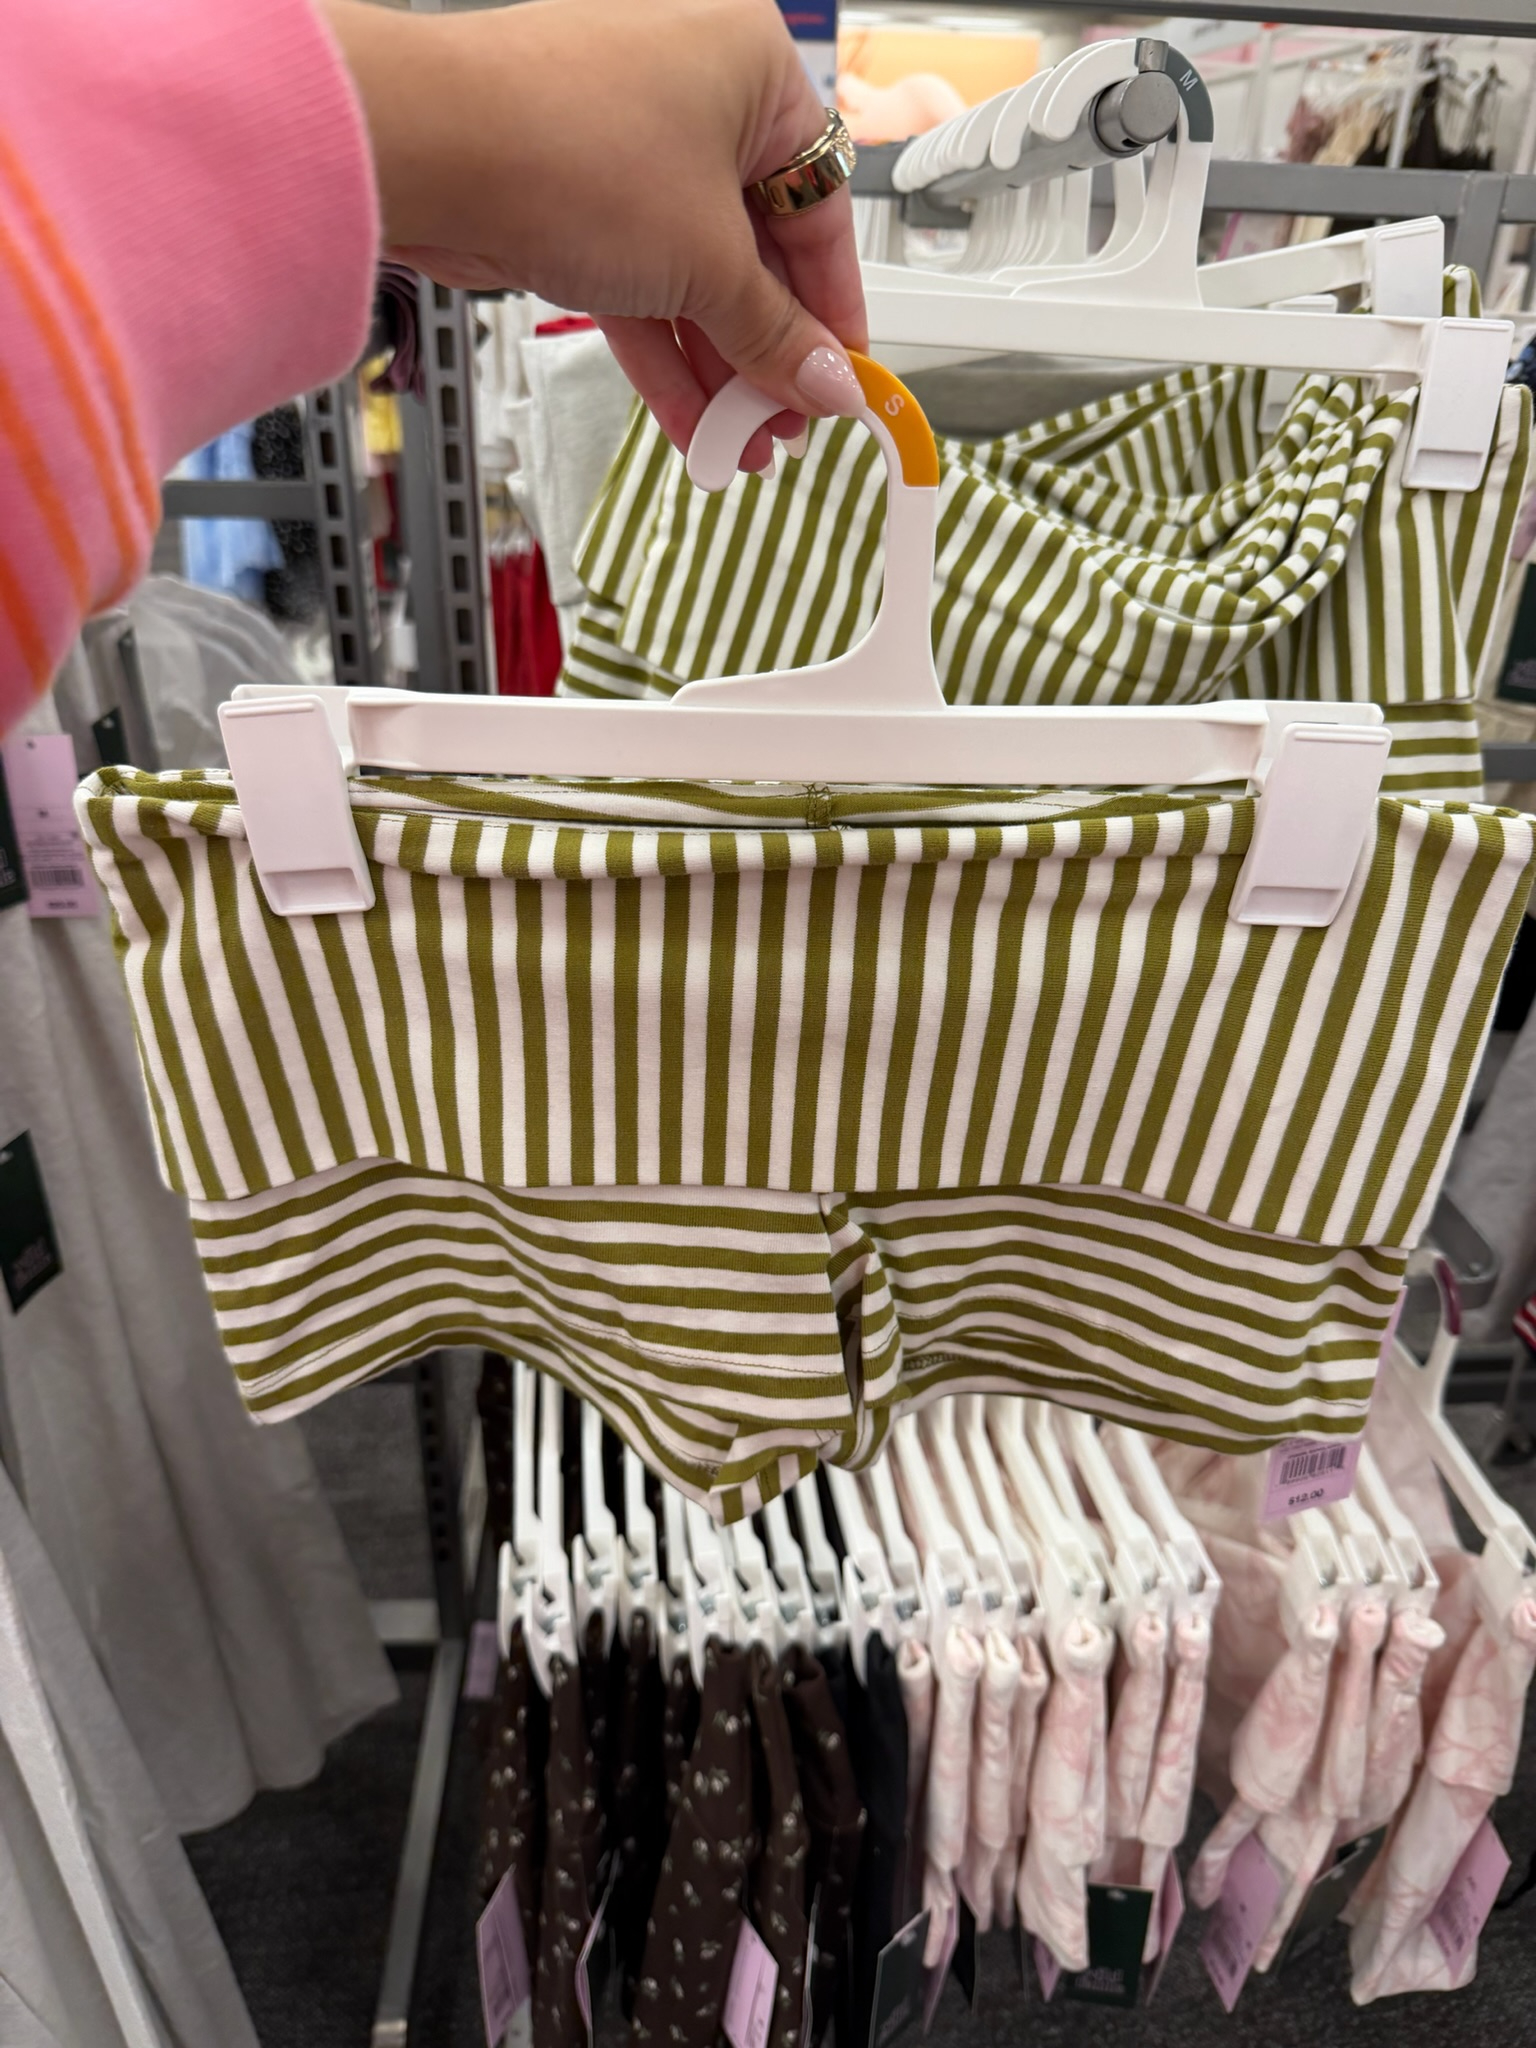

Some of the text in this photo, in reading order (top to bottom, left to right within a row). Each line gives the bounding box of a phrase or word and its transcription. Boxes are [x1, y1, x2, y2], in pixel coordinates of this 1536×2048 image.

[1180, 69, 1198, 91] M
[885, 394, 904, 416] S
[1288, 1488, 1325, 1506] $12.00
